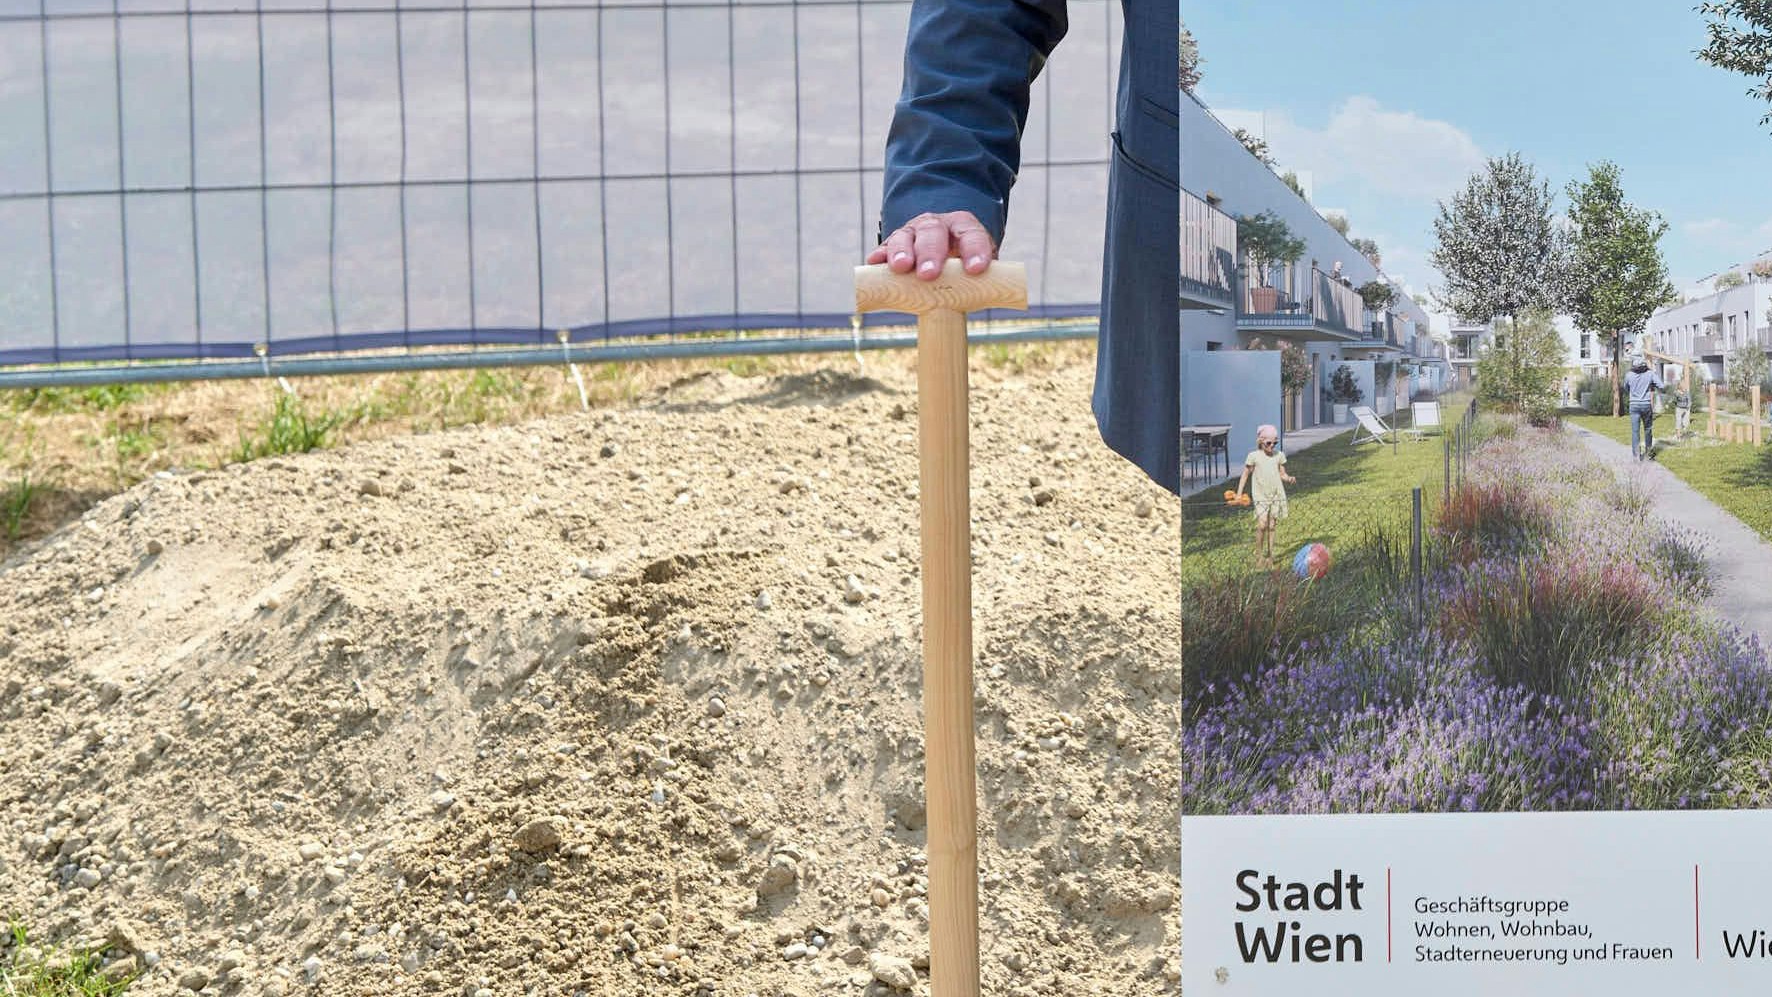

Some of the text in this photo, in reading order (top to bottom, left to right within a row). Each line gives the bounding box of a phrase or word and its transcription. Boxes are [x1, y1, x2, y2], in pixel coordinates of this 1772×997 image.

[1235, 868, 1365, 913] Stadt
[1414, 895, 1569, 918] Geschäftsgruppe
[1414, 919, 1593, 941] Wohnen, Wohnbau,
[1234, 921, 1363, 964] Wien
[1415, 942, 1673, 966] Stadterneuerung und Frauen
